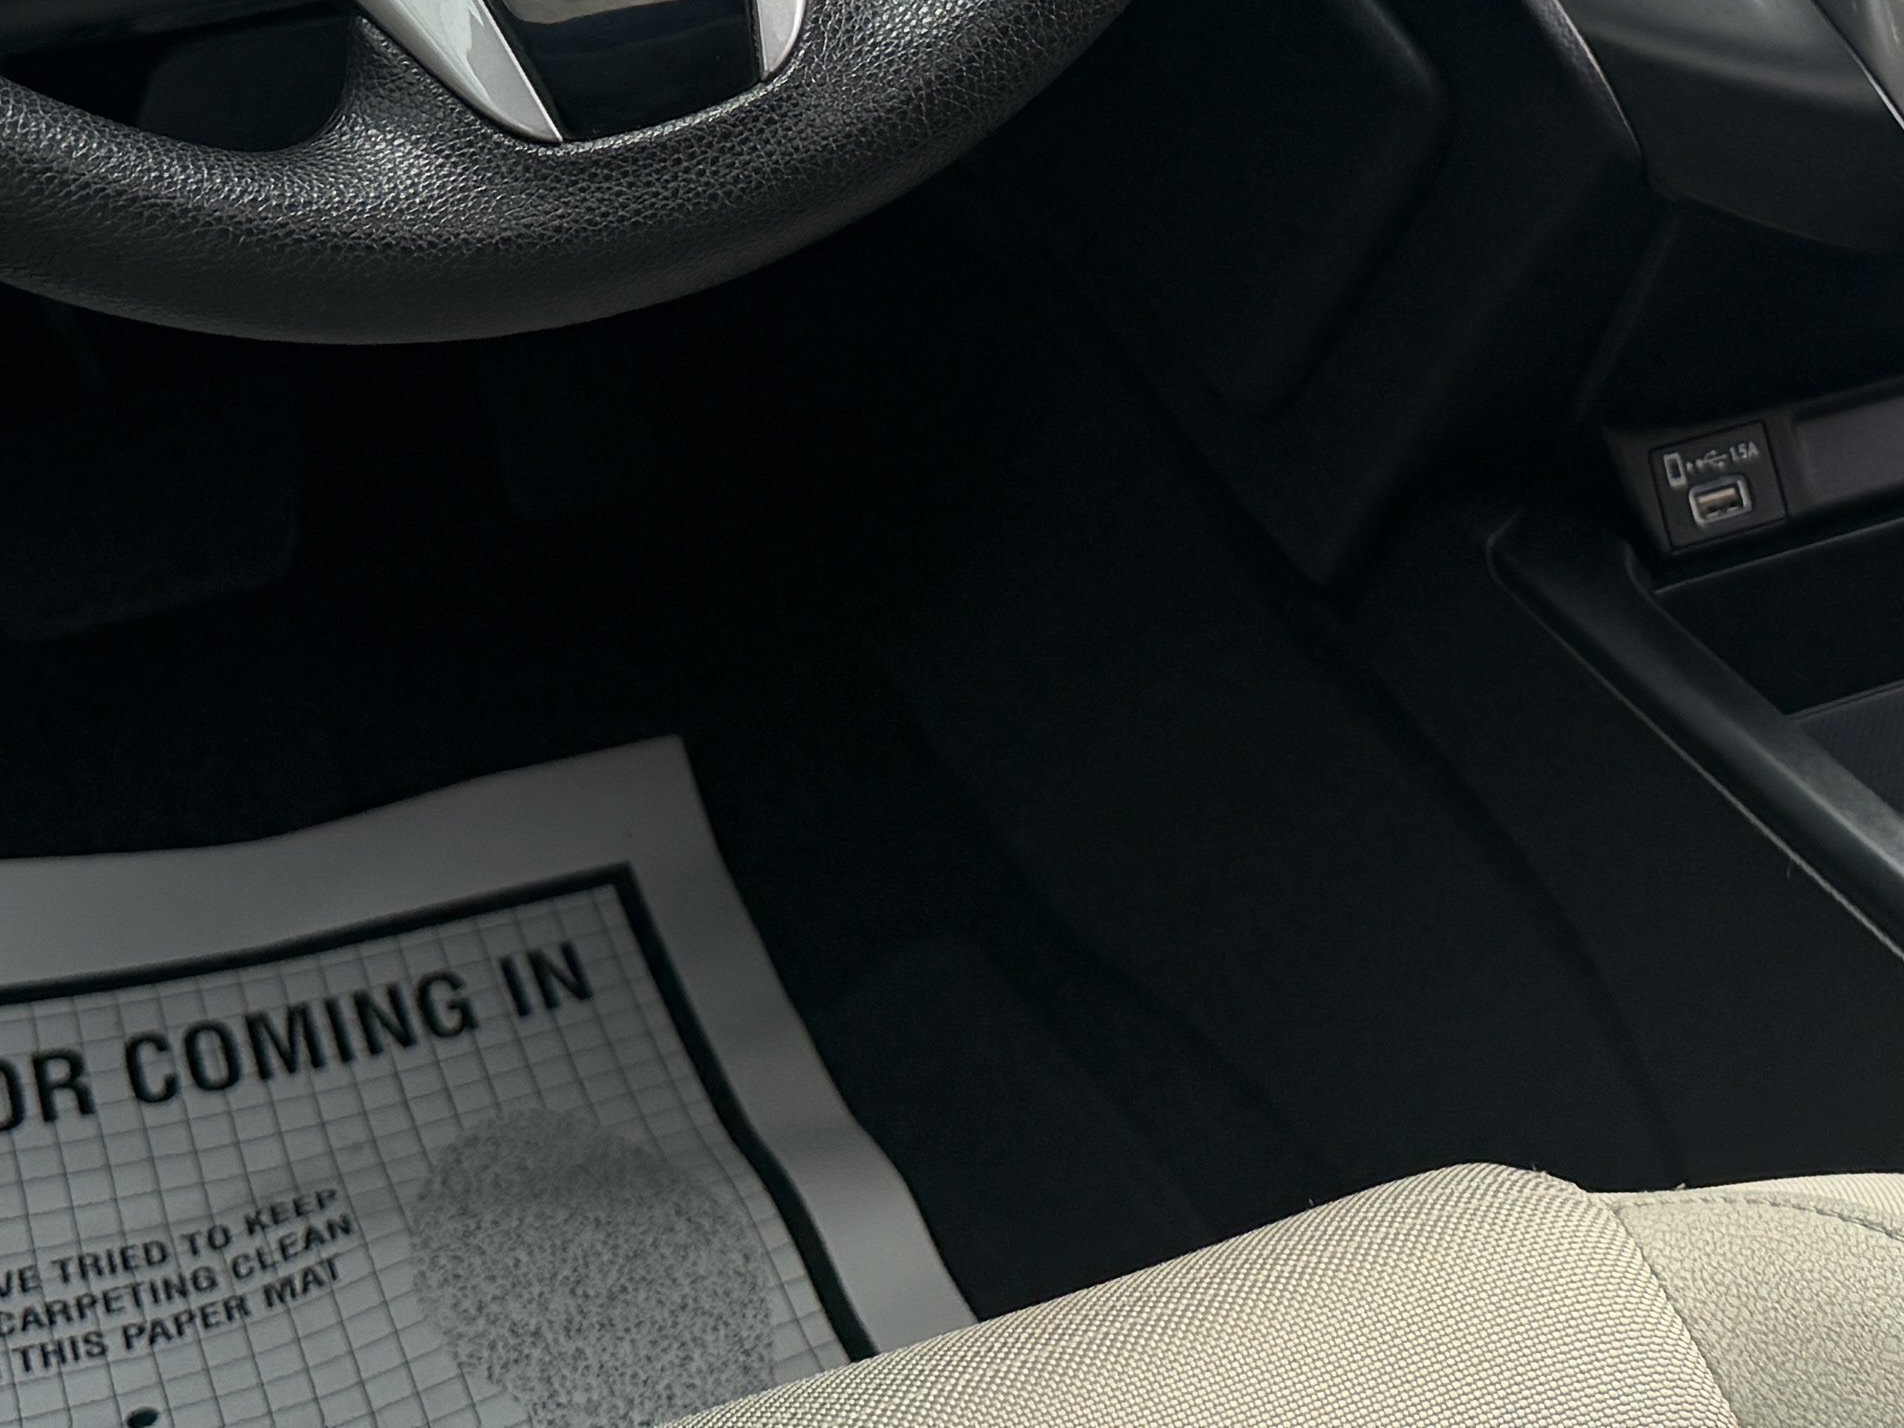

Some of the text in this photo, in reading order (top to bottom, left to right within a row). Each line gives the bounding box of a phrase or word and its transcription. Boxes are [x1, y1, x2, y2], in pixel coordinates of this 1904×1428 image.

[124, 967, 481, 1106] COMING
[500, 939, 595, 1019] IN
[51, 1239, 171, 1287] TRIED
[180, 1222, 233, 1259] TO
[243, 1186, 340, 1238] KEEP
[231, 1212, 354, 1281] CLEAN
[11, 1329, 107, 1375] THIS
[121, 1293, 253, 1351] PAPER
[261, 1255, 343, 1309] MAT
